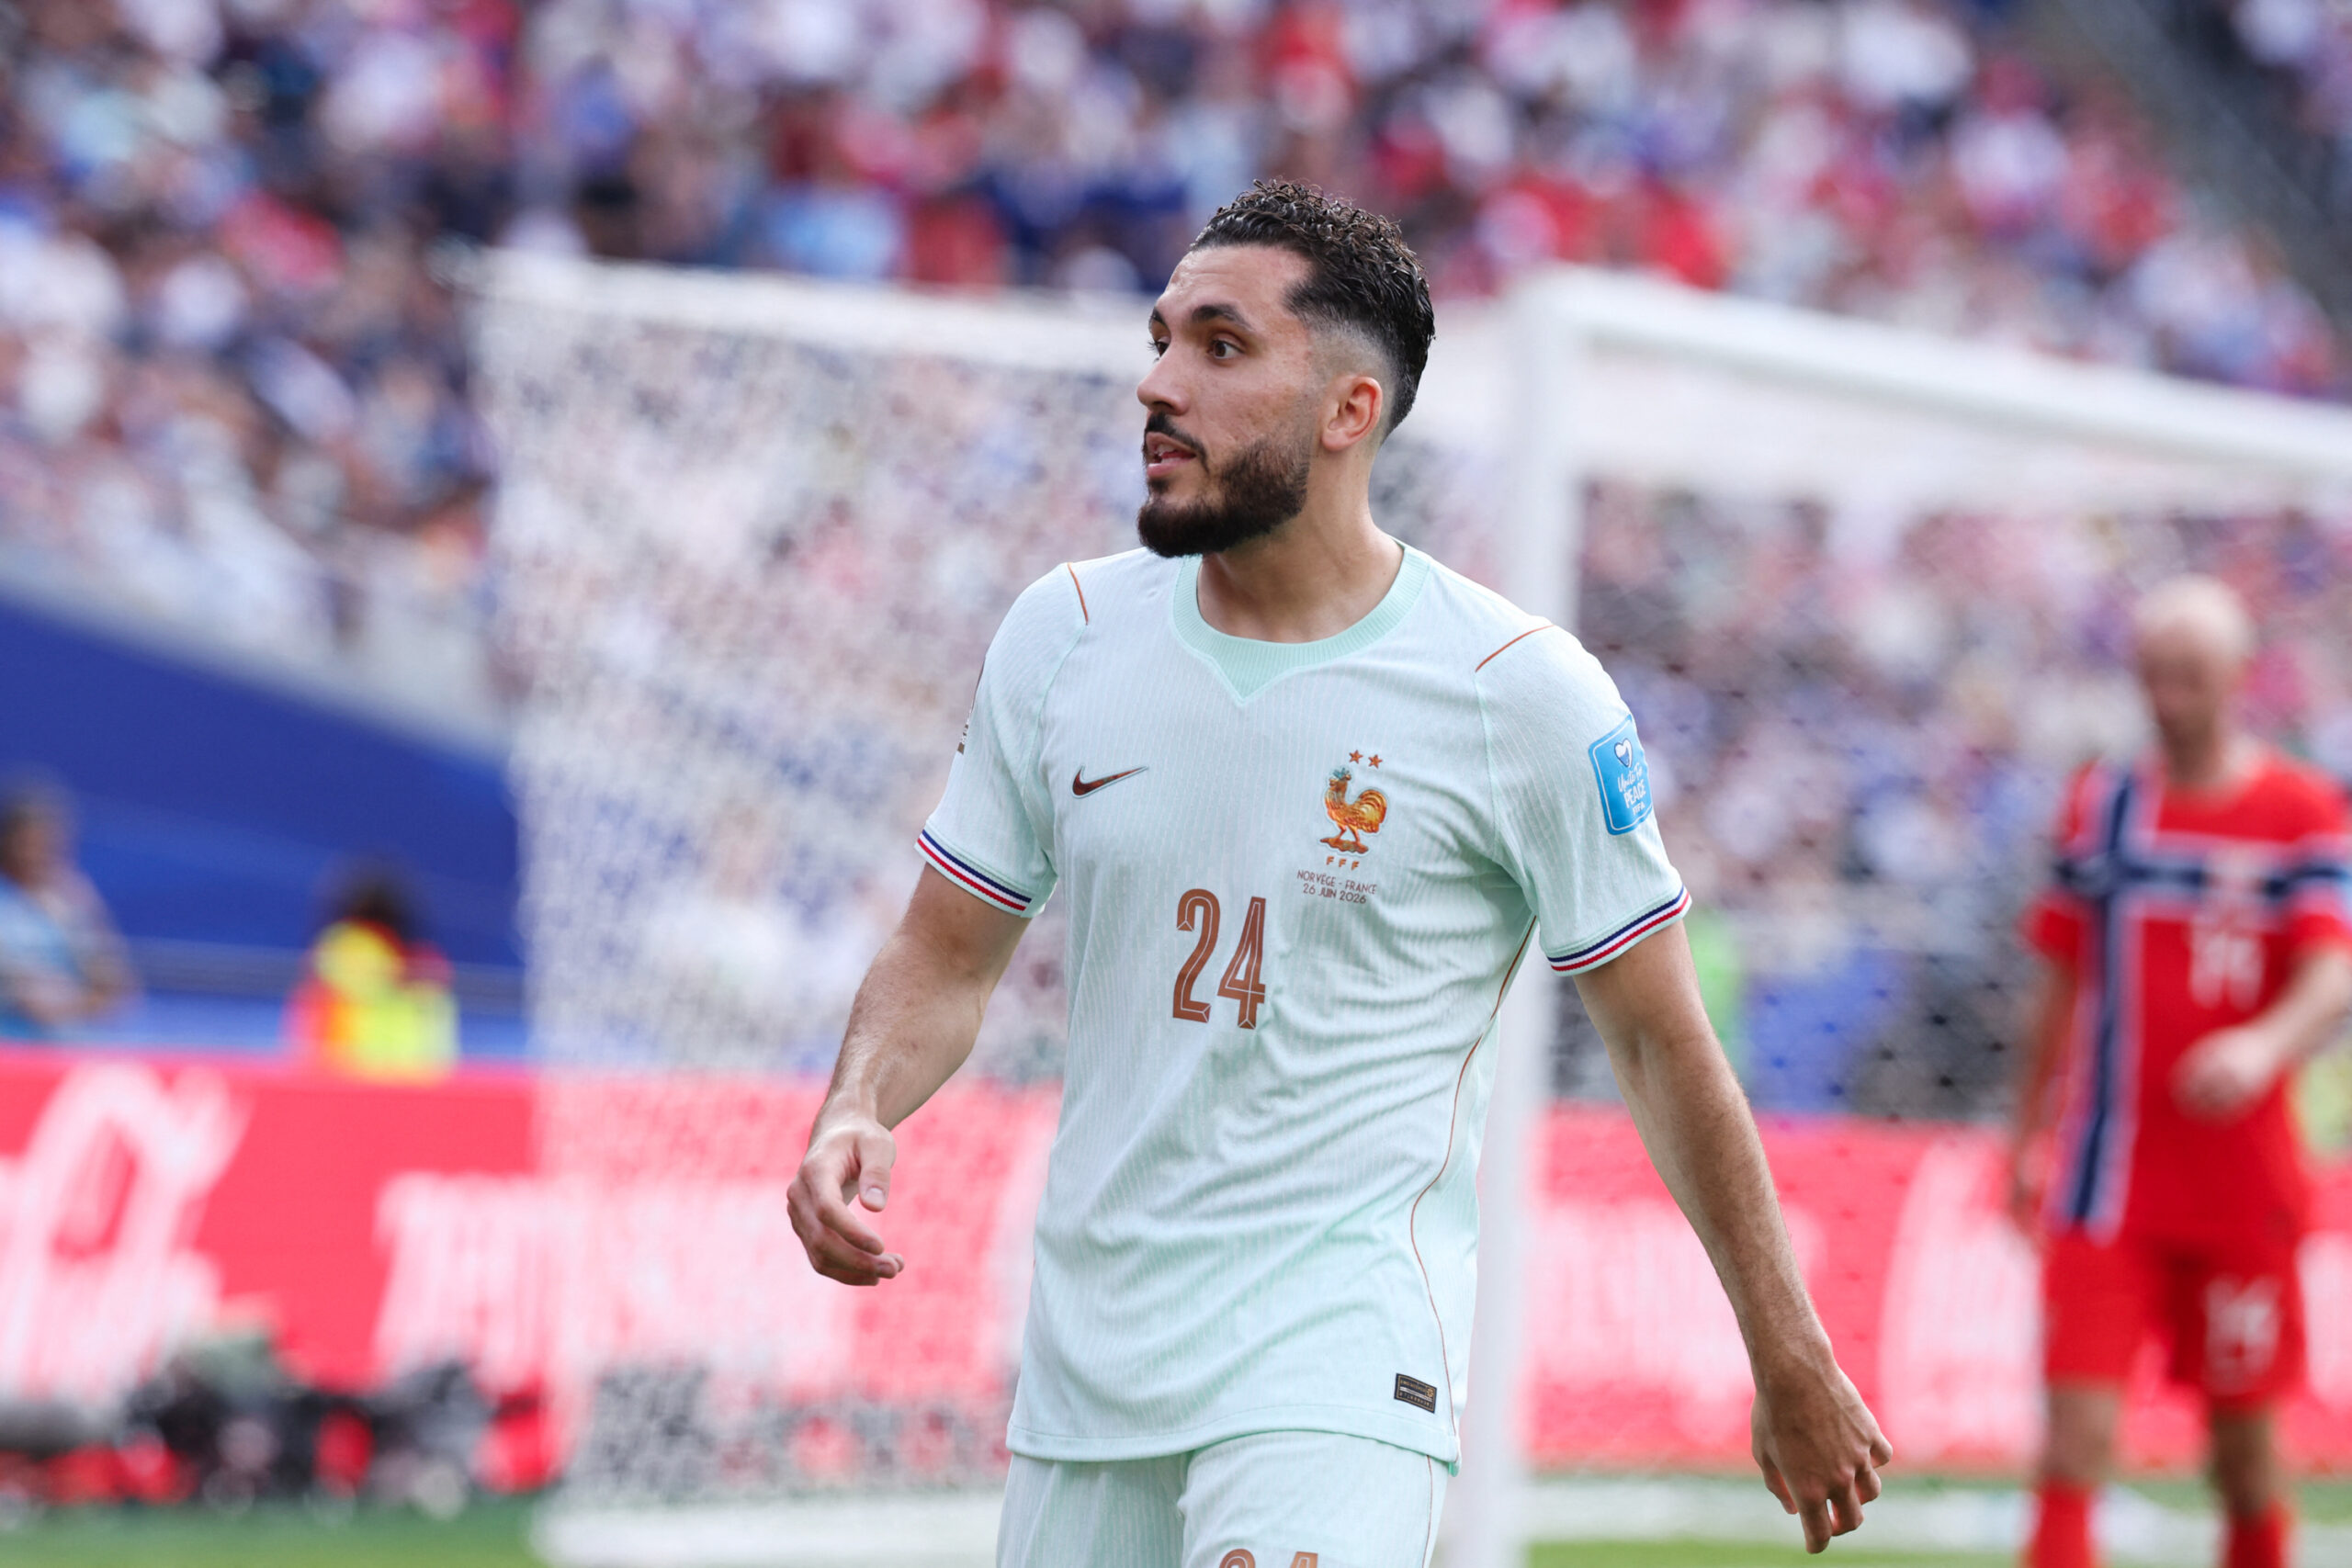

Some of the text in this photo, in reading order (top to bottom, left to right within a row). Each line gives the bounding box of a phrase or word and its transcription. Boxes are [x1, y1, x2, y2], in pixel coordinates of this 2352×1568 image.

[1303, 883, 1367, 905] 26 JUIN 2026
[1345, 879, 1377, 895] FRANCE
[1173, 888, 1266, 1030] 24
